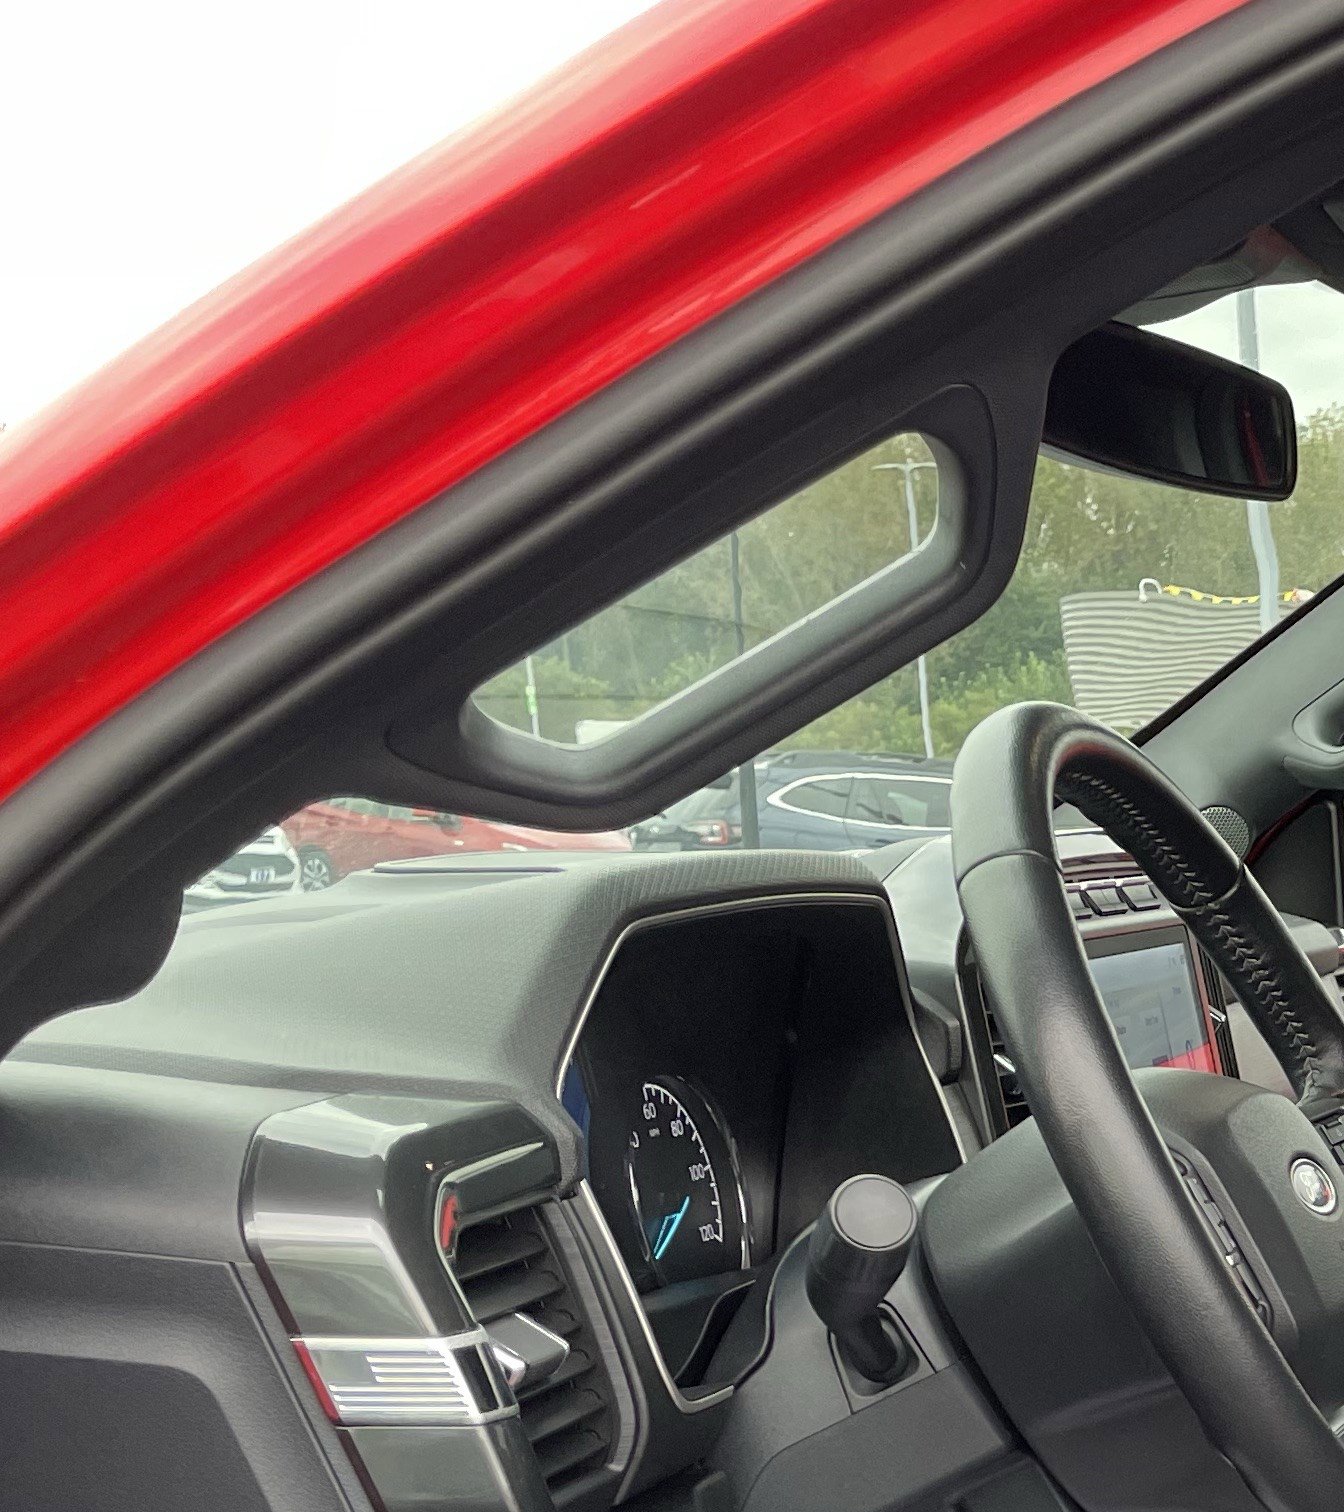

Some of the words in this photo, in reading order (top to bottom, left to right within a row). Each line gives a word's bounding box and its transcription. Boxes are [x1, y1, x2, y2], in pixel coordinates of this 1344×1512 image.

[643, 1102, 657, 1120] 60
[670, 1119, 684, 1137] 80
[688, 1163, 705, 1181] 100
